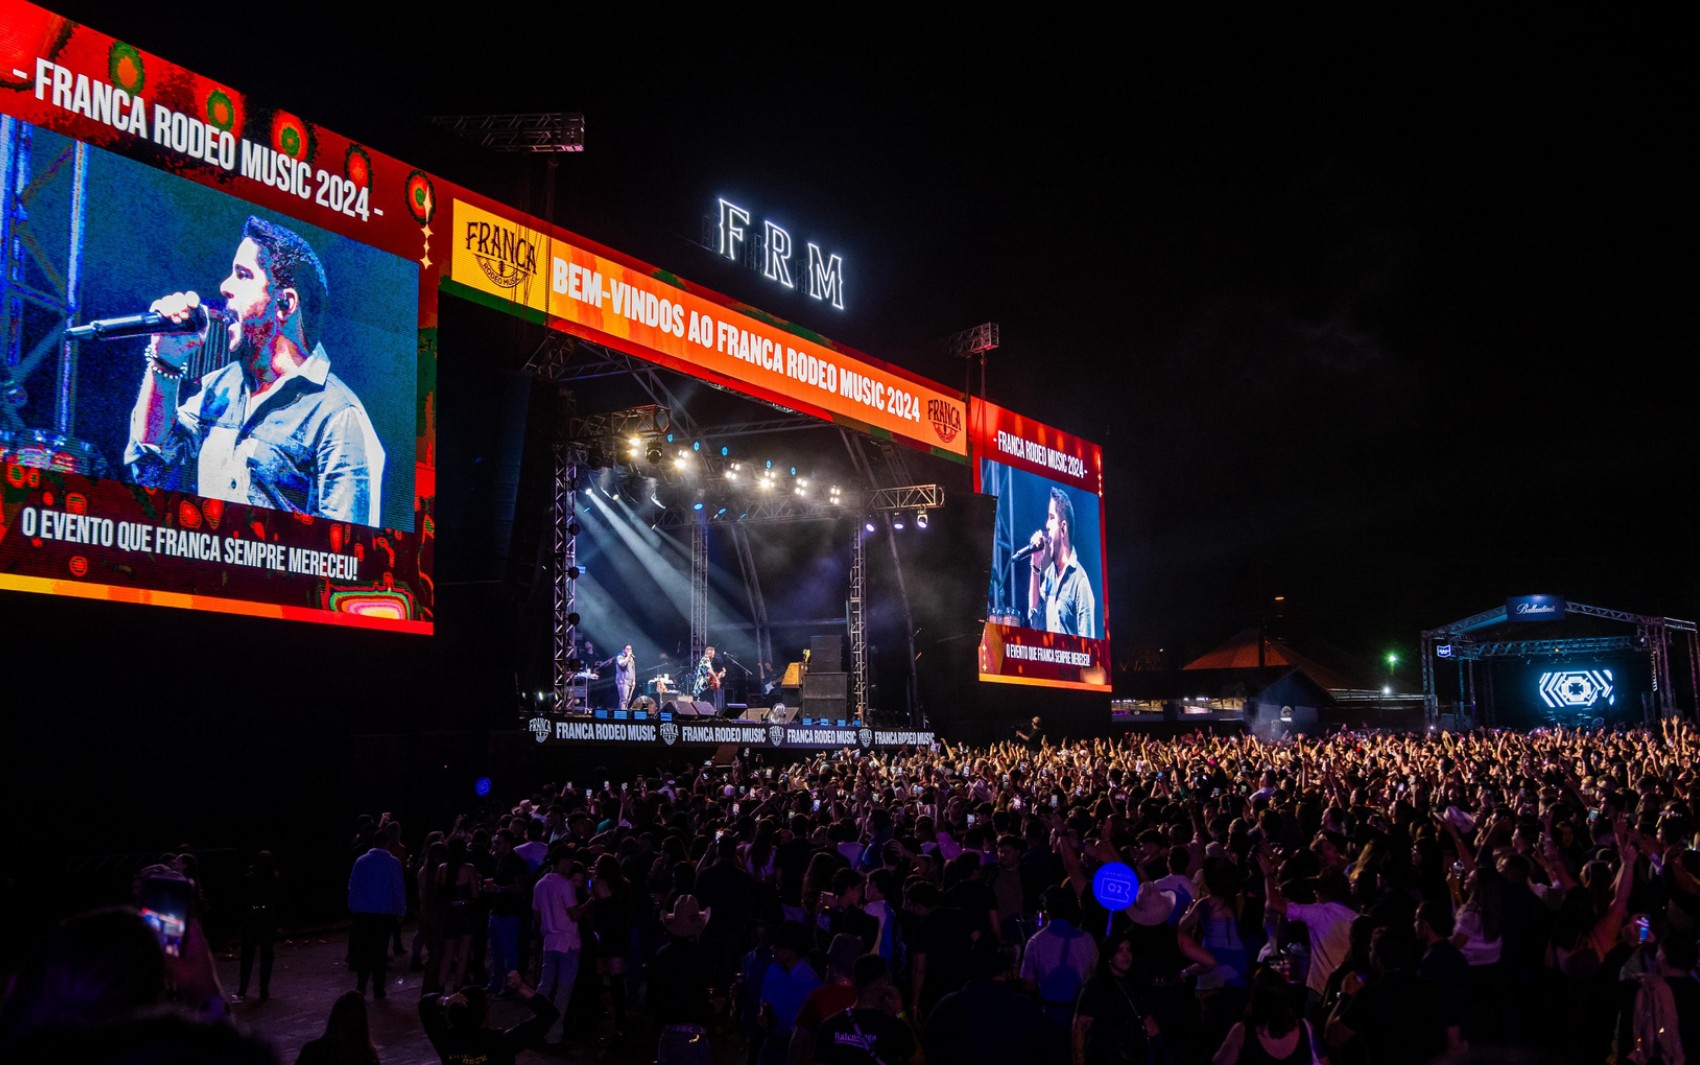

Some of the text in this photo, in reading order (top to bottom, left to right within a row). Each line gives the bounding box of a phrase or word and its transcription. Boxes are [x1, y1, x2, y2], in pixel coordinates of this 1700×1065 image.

[35, 57, 147, 139] FRANCA
[153, 103, 235, 170] RODEO
[241, 138, 312, 199] MUSIC
[315, 169, 370, 222] 2024
[466, 221, 537, 275] FRANCA
[482, 262, 503, 285] RODEO
[553, 257, 921, 423] BEM-VINDOS AO FRANCA RODEO MUSIC 2024
[927, 399, 962, 431] FRANCA
[998, 430, 1025, 459] FRANCA
[1025, 441, 1047, 466] RODEO
[1047, 448, 1068, 473] MUSIC
[1068, 456, 1084, 479] 2024
[22, 507, 358, 581] O EVENTO QUE FRANCA SEMPRE MERECEU!
[556, 722, 594, 740] FRANCA
[595, 723, 627, 741] RODEO
[627, 724, 656, 742] MUSIC
[682, 726, 714, 742] FRANCA
[714, 727, 741, 742] RODEO
[742, 728, 766, 743] MUSIC
[787, 729, 814, 744] FRANCA
[814, 729, 836, 744] RODEO
[836, 730, 857, 745] MUSIC
[874, 731, 898, 745] FRANCA
[898, 732, 916, 745] RODEO
